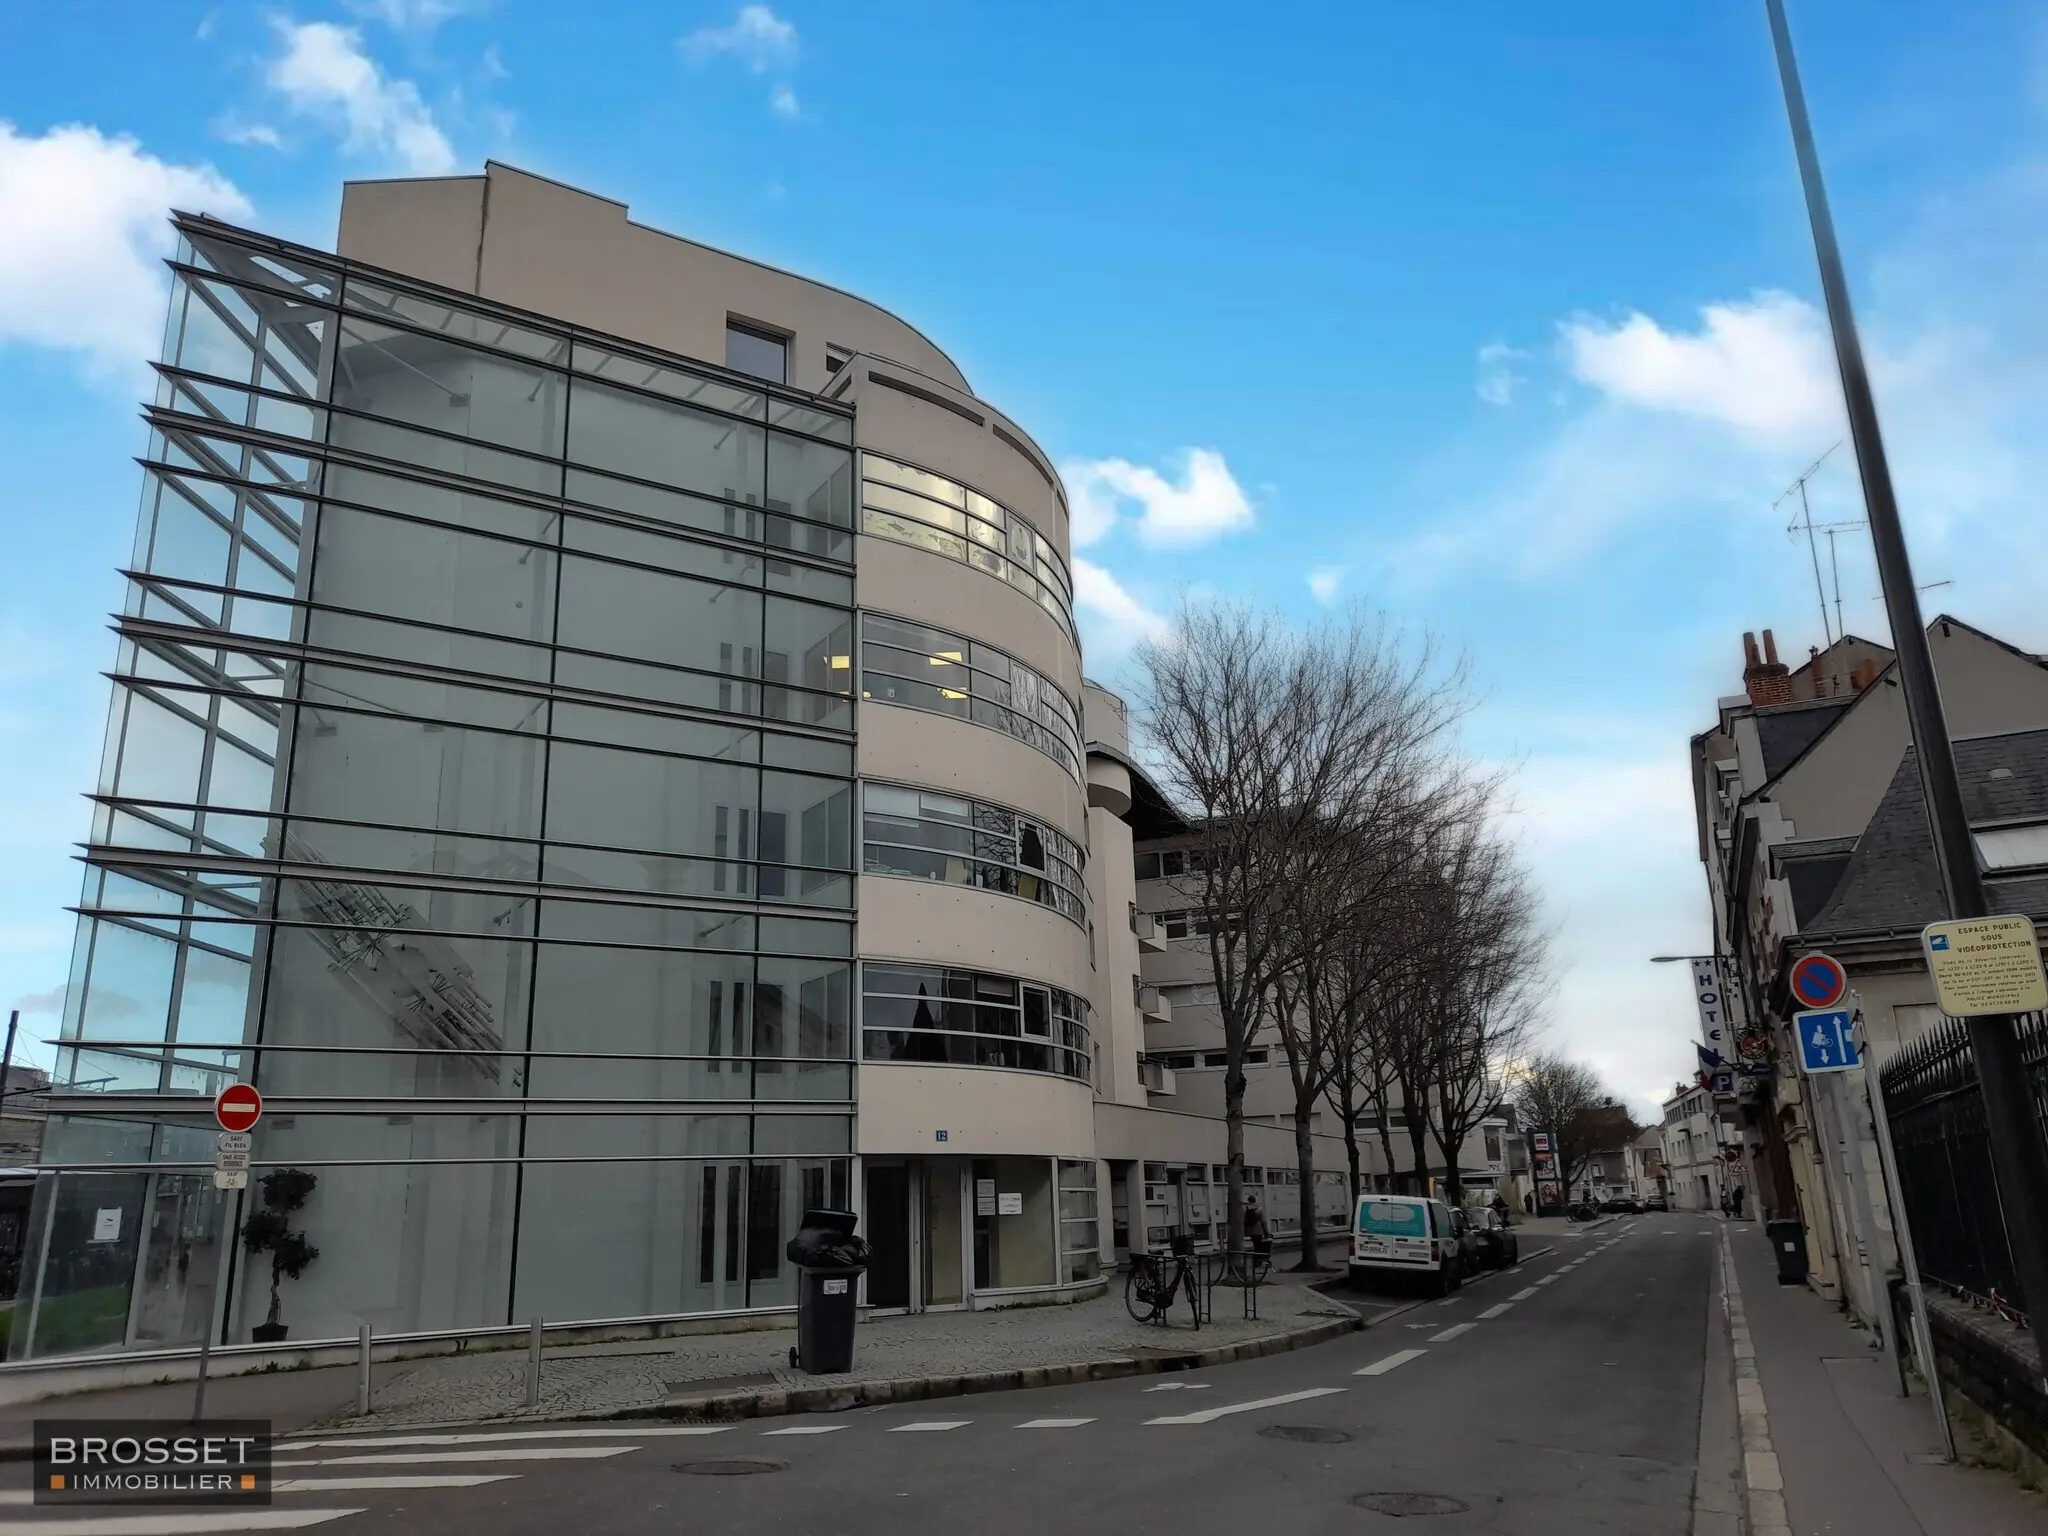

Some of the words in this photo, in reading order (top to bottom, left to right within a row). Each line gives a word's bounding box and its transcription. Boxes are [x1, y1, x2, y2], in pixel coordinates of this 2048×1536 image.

[1958, 925, 1989, 935] ESPACE
[1993, 922, 2022, 931] PUBLIC
[1980, 933, 2003, 941] SOUS
[1719, 1076, 1730, 1088] P
[938, 1132, 947, 1140] 12
